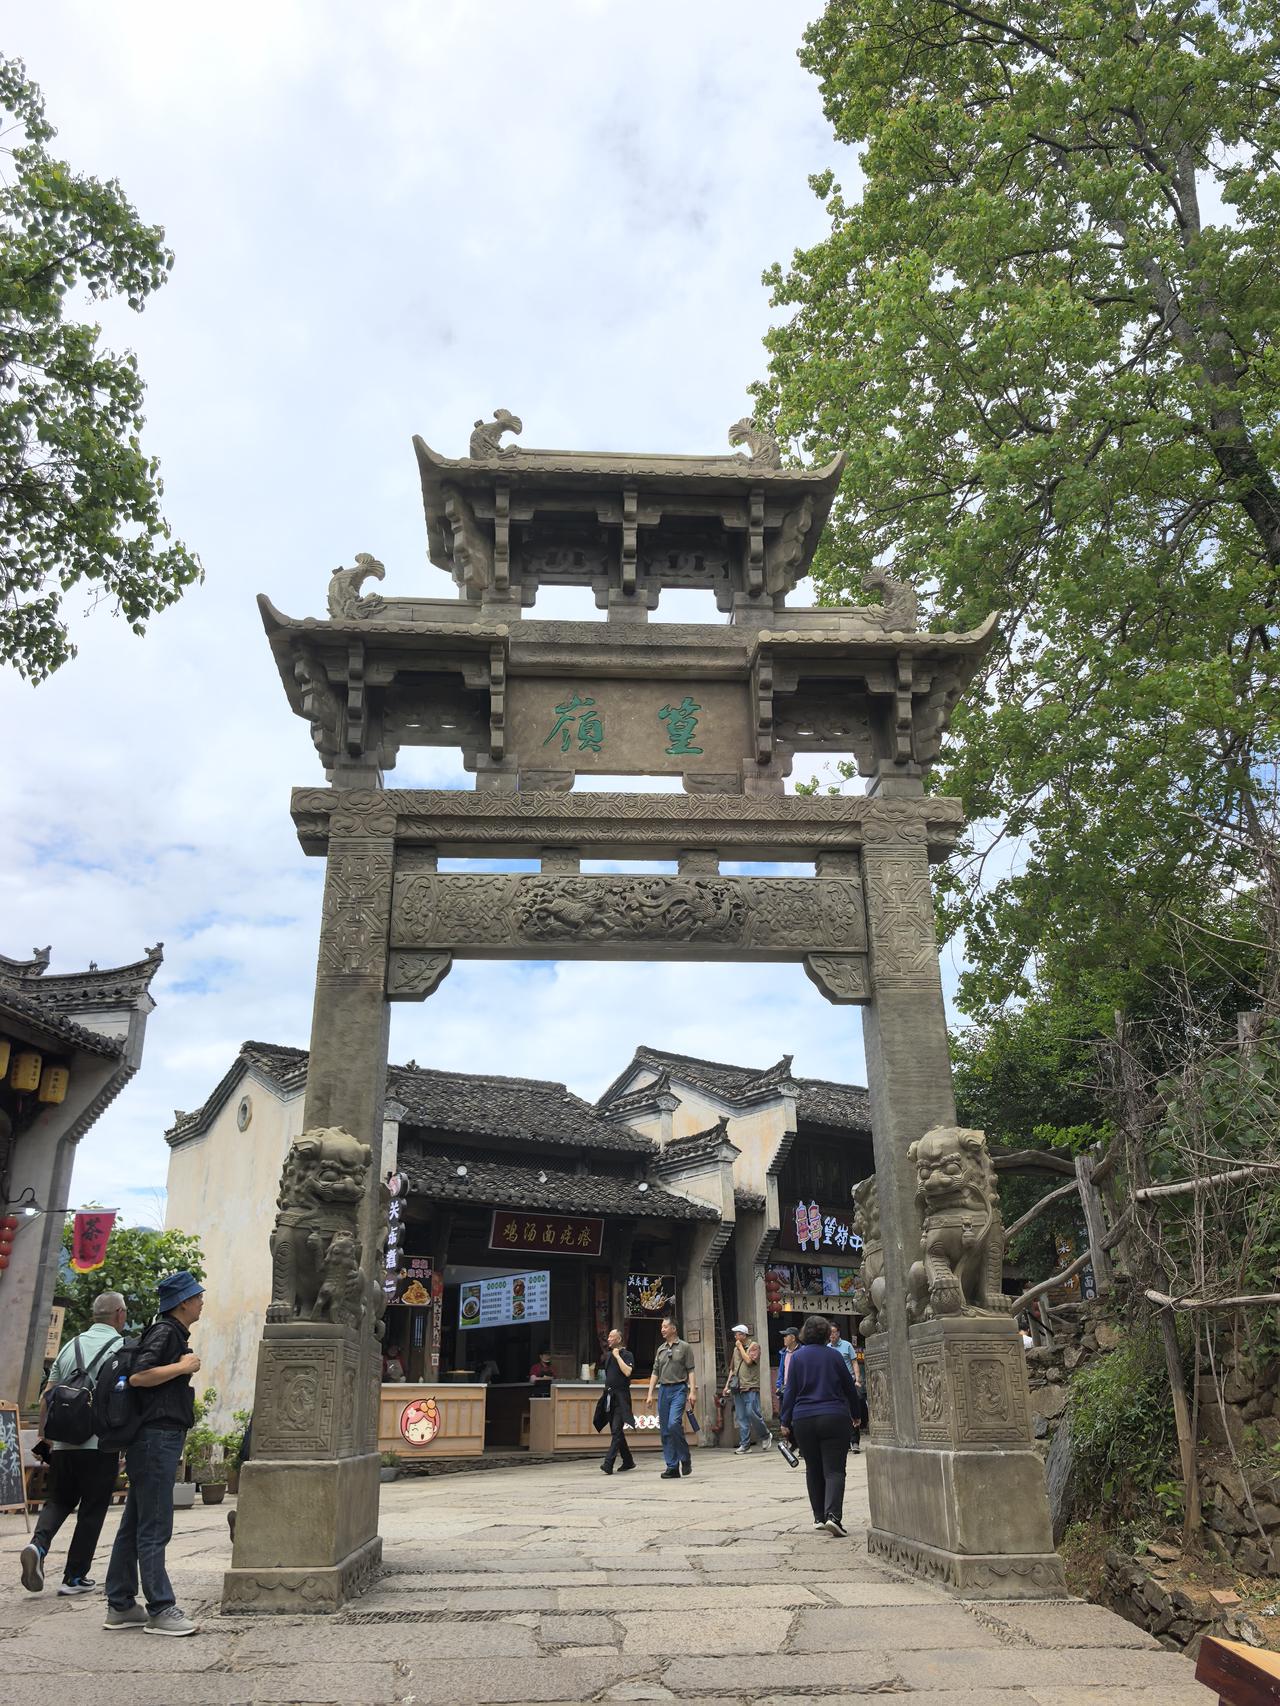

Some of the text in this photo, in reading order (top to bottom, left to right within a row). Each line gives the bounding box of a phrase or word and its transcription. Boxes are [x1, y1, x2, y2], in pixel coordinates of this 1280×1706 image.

[503, 1220, 592, 1247] 鸡汤面疙瘩
